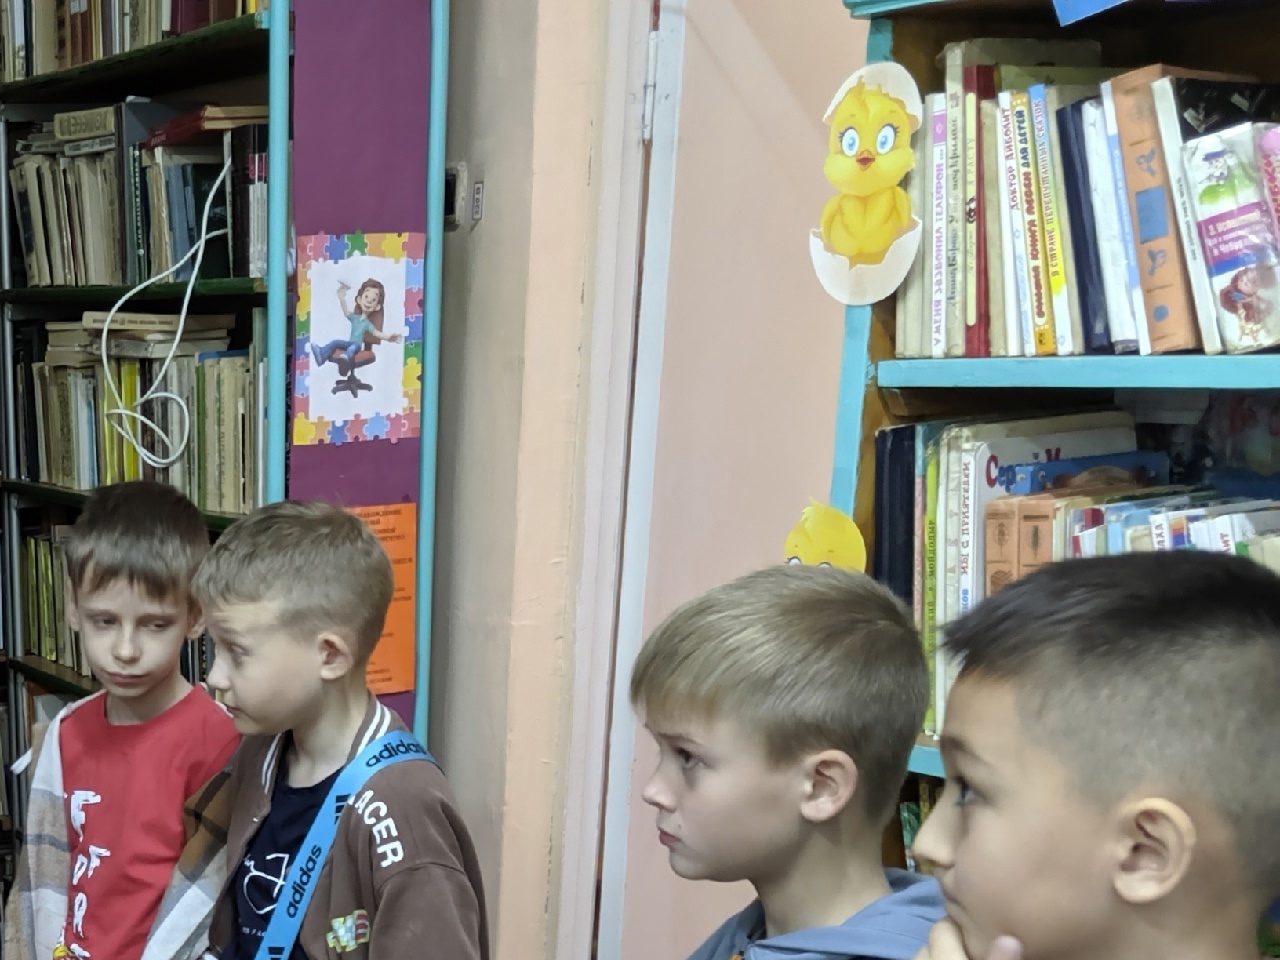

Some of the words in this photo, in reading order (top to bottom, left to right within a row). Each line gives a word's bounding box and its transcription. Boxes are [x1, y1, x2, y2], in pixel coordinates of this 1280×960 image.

[1001, 106, 1016, 162] АЙБОЛИТ
[1014, 109, 1026, 147] ДЕТЕЙ
[1032, 100, 1045, 139] СКАЗОК
[1020, 147, 1031, 169] ДЛЯ
[1005, 165, 1021, 210] ДОКТОР
[1023, 171, 1036, 216] ПЕСЕН
[933, 226, 944, 295] ЗАЗВОНИЛ
[1027, 219, 1041, 261] КНИГА
[933, 301, 943, 336] МЕНЯ
[960, 460, 971, 536] ПРИЯТЕЛЕМ
[927, 519, 936, 578] МОЙДОДЫР
[960, 556, 970, 576] МЫ
[365, 739, 428, 768] adidas
[347, 789, 405, 868] ACER
[285, 844, 323, 919] adidas
